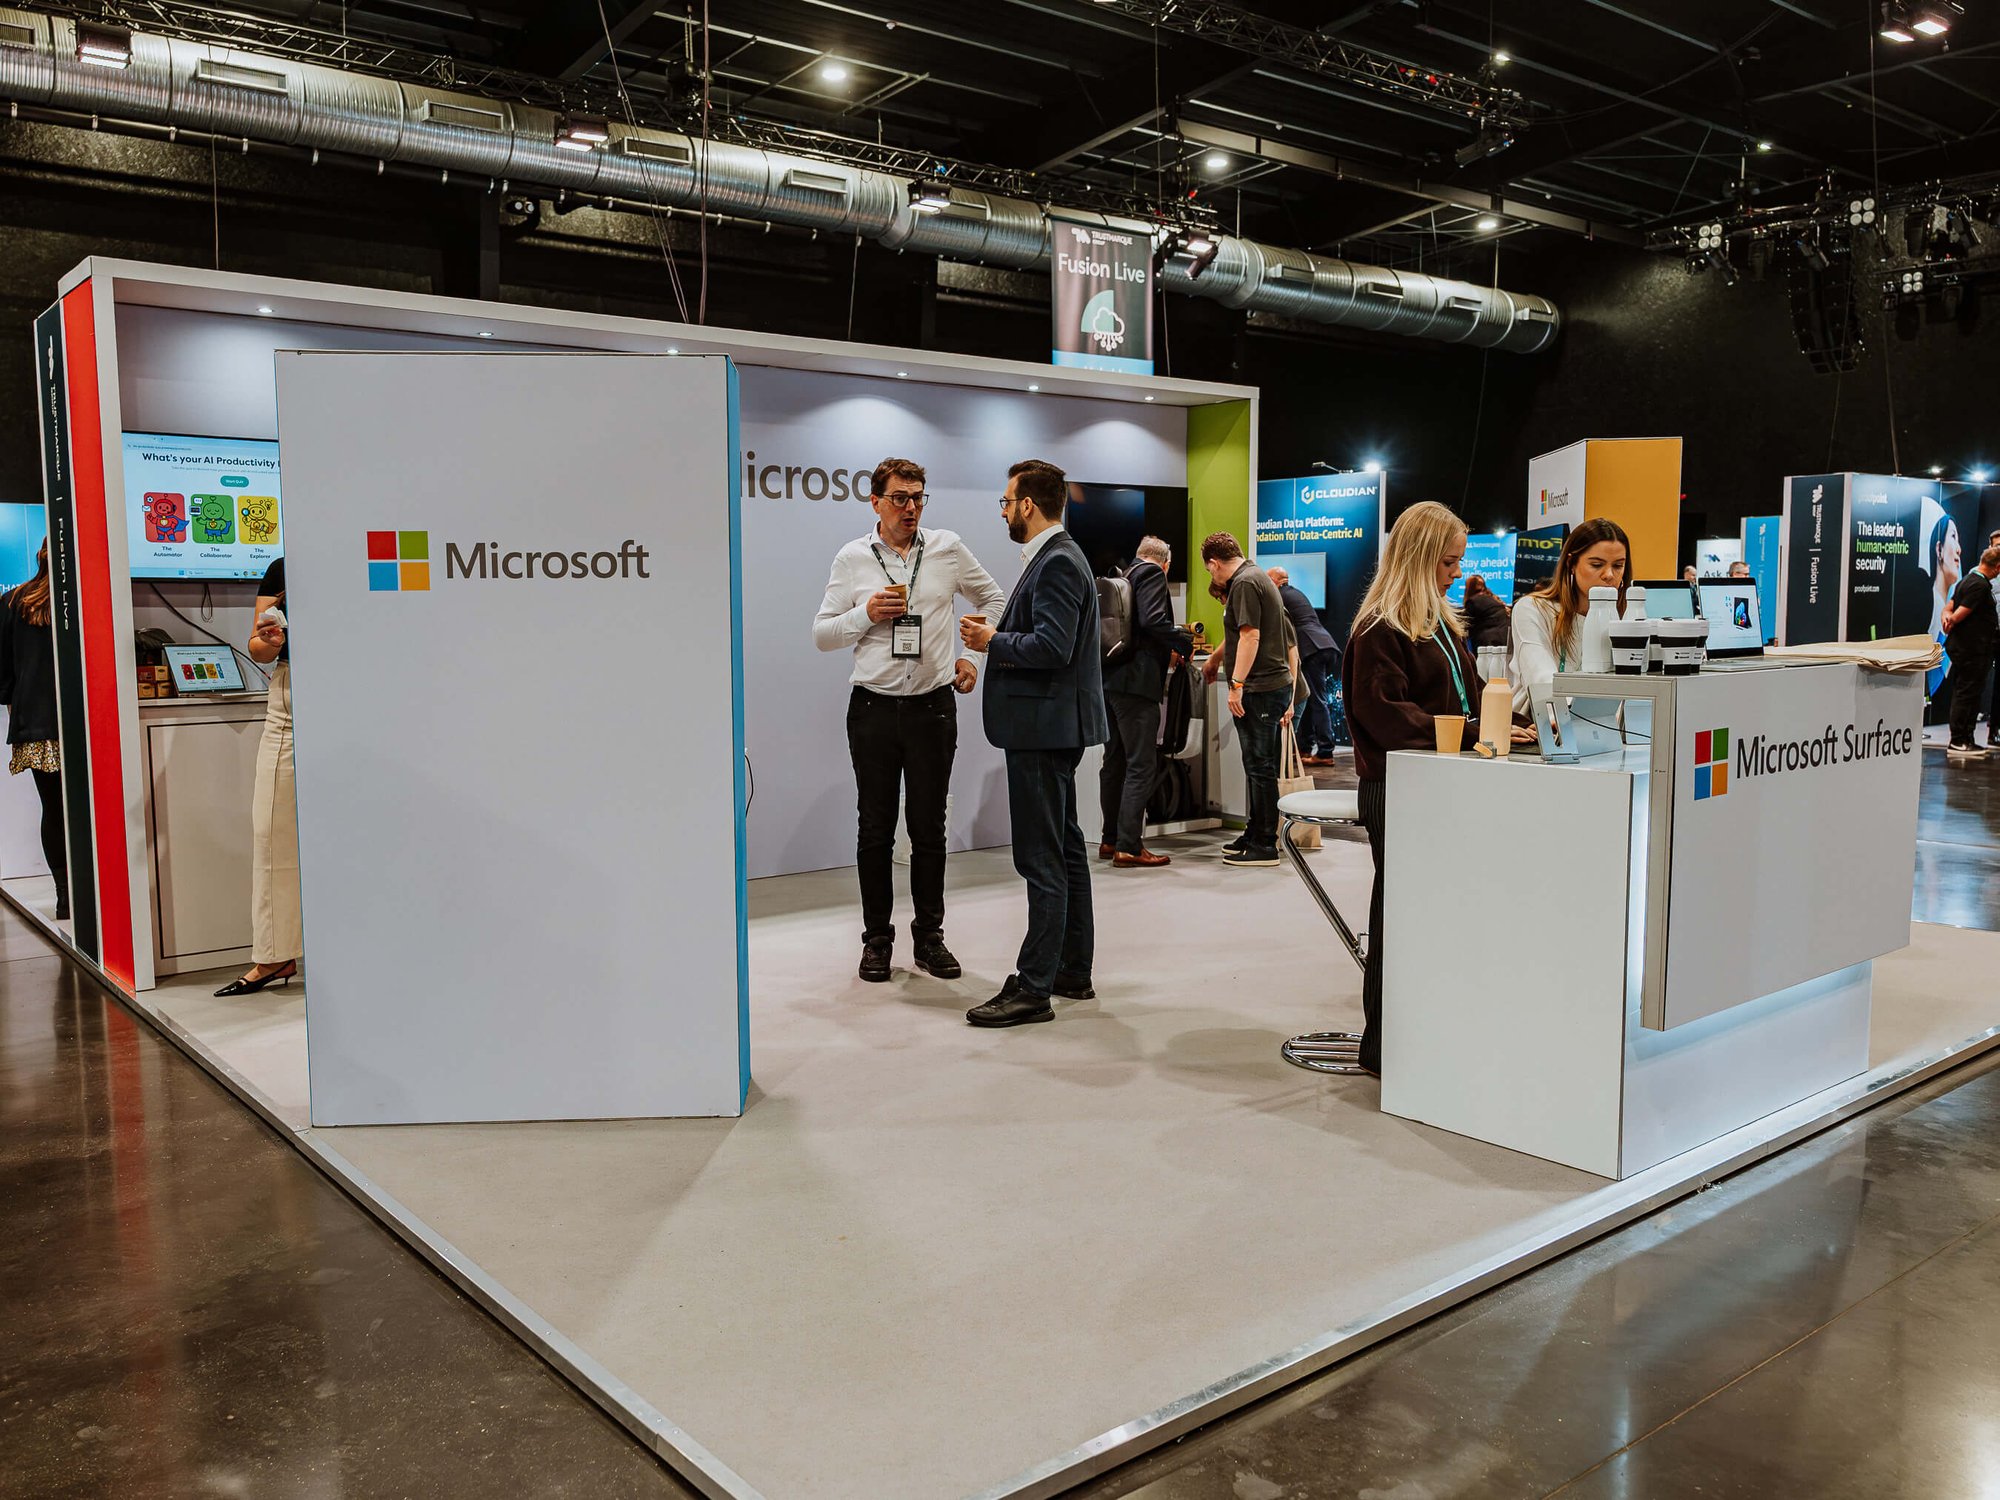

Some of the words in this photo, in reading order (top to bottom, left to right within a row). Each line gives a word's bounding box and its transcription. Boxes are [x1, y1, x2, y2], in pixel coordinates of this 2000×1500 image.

[1091, 230, 1133, 246] TRUSTMARQUE
[1058, 252, 1110, 278] Fusion
[1115, 261, 1146, 283] Live
[142, 452, 178, 463] What's
[179, 455, 202, 465] your
[203, 456, 214, 464] AI
[216, 456, 276, 468] Productivity
[740, 450, 872, 502] icroso
[1316, 486, 1376, 499] CLOUDIAN
[1548, 488, 1569, 509] Microsoft
[1283, 518, 1304, 529] Data
[1305, 516, 1344, 528] Platform:
[1857, 521, 1872, 535] The
[1873, 522, 1895, 537] leader
[1896, 523, 1904, 537] in
[1286, 530, 1299, 541] for
[1300, 527, 1352, 541] Data-Centric
[1353, 529, 1363, 539] AI
[58, 517, 66, 583] Fusion
[1856, 539, 1910, 555] human-centric
[445, 539, 650, 579] Microsoft
[1459, 558, 1478, 570] Stay
[1480, 557, 1508, 567] ahead
[1855, 555, 1887, 574] security
[1461, 571, 1501, 581] ntelligent
[1810, 556, 1820, 585] Fusion
[1809, 585, 1818, 604] Live
[1736, 724, 1838, 779] Microsoft
[1843, 718, 1912, 762] Surface
